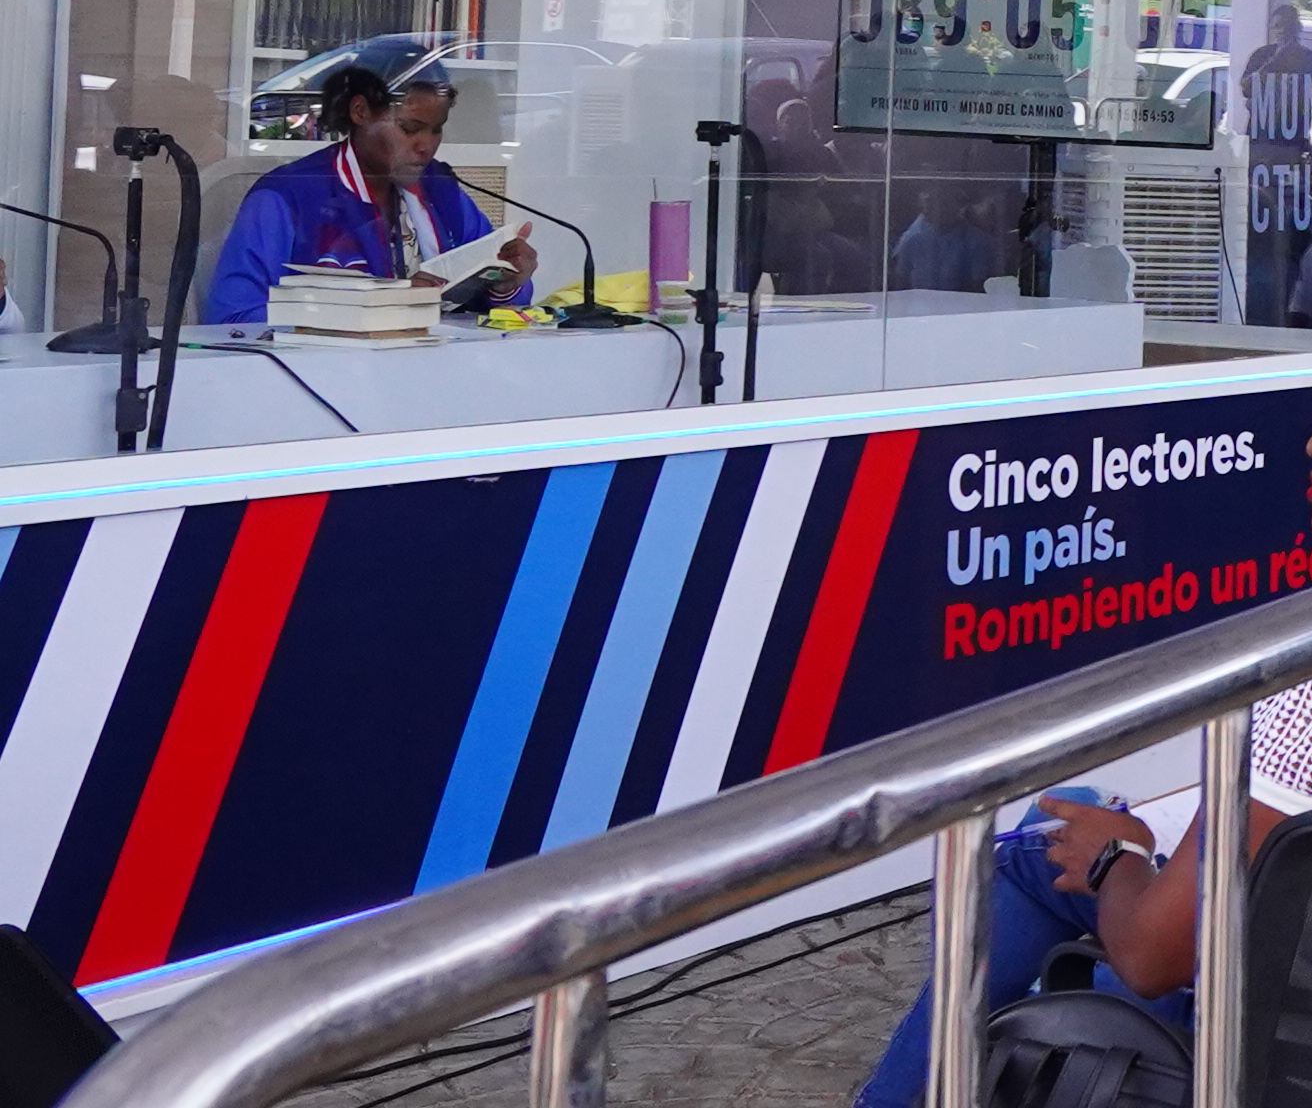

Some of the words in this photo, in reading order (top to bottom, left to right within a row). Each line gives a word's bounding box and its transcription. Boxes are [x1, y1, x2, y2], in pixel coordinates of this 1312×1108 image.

[923, 99, 949, 113] HITO
[959, 99, 993, 115] MITAD
[997, 102, 1016, 116] DEL
[1020, 104, 1065, 118] CAMINO
[948, 449, 1079, 512] Cinco
[1091, 430, 1265, 493] lectores.
[946, 527, 1010, 586] Un
[1023, 506, 1126, 585] país.
[943, 563, 1200, 660] Rompiendo
[1210, 557, 1258, 604] un
